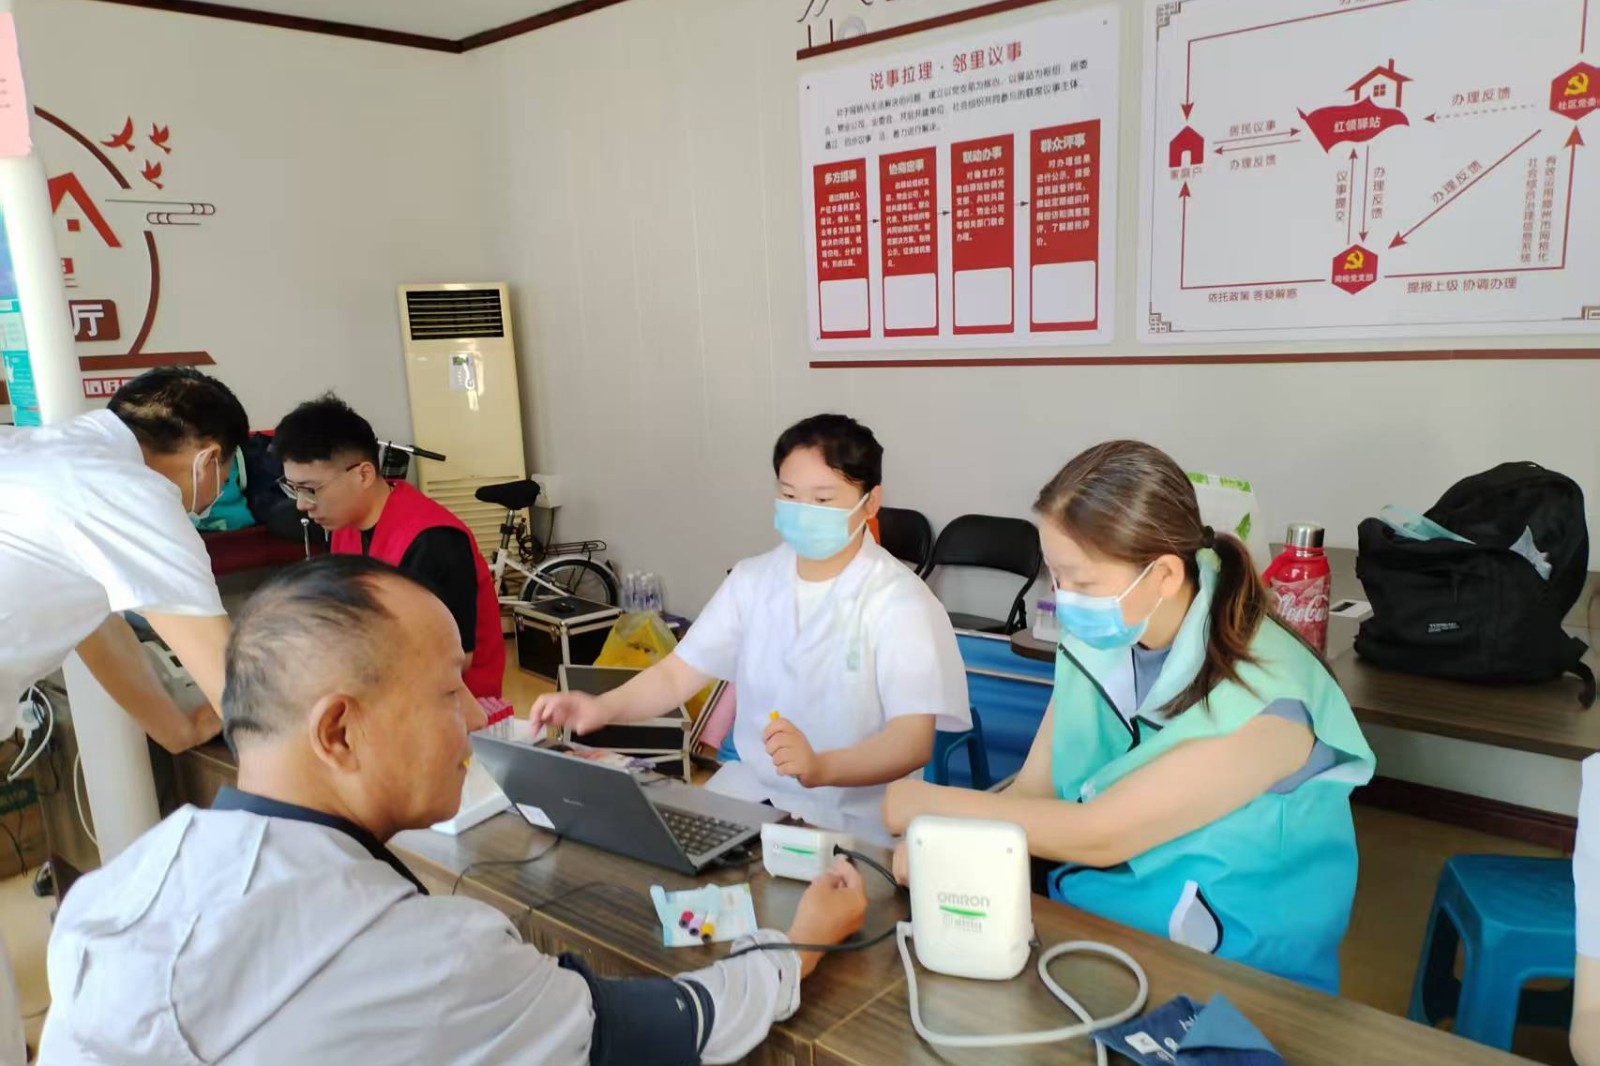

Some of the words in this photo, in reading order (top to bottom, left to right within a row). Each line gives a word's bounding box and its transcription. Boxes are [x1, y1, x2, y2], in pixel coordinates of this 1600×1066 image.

[1451, 86, 1511, 106] 办理反馈
[1229, 120, 1276, 137] 居民议事
[1333, 116, 1381, 133] 红领驿站
[1040, 132, 1086, 153] 群众评事
[1229, 154, 1276, 170] 办理反馈
[1431, 160, 1483, 204] 办理反馈
[1371, 166, 1385, 220] 办理反馈
